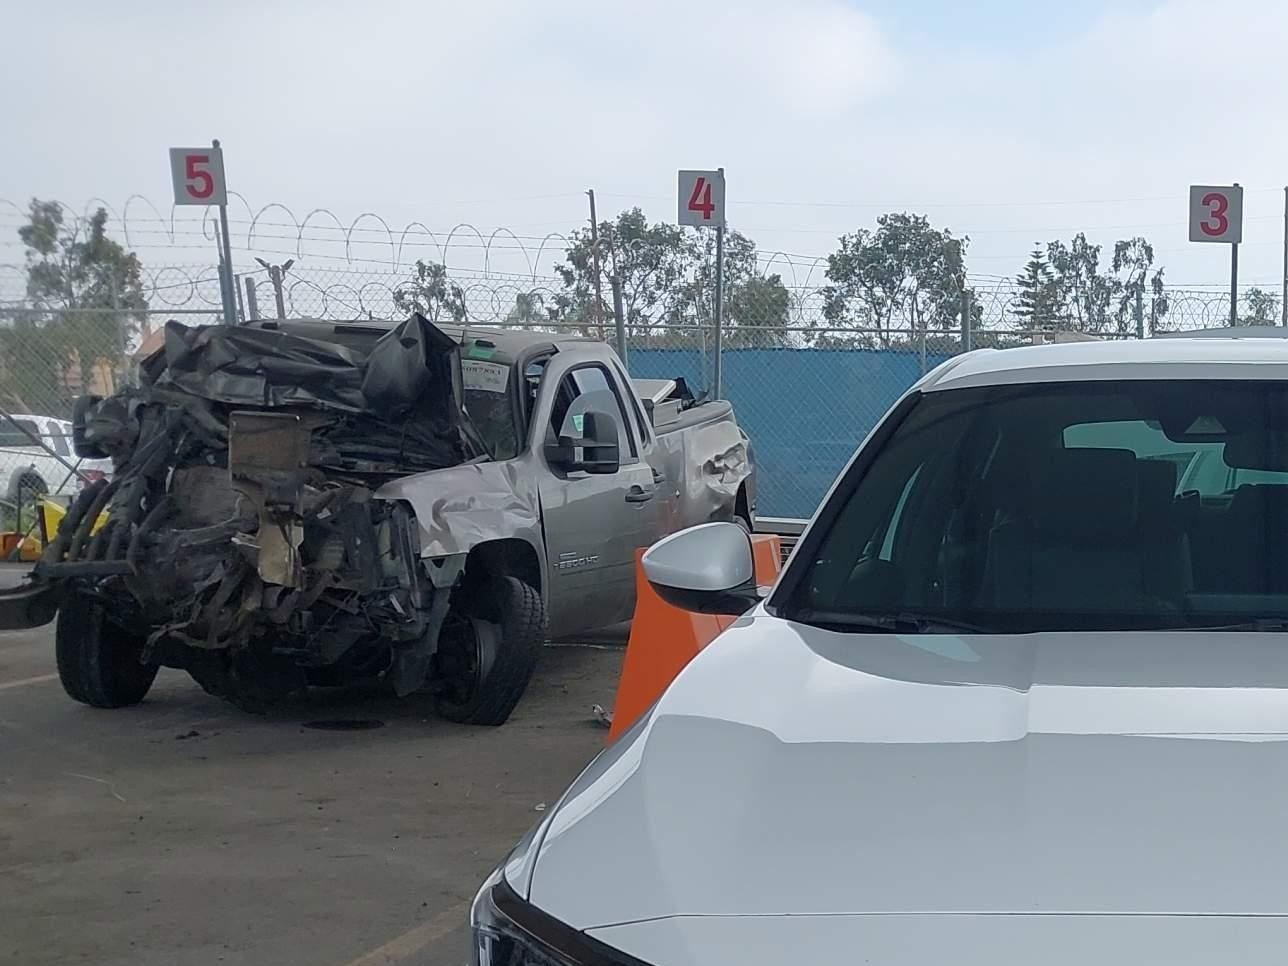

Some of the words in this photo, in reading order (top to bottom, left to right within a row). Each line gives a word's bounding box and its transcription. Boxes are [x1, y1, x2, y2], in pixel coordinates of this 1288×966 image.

[185, 155, 214, 198] 5
[687, 177, 716, 220] 4
[1199, 193, 1229, 236] 3
